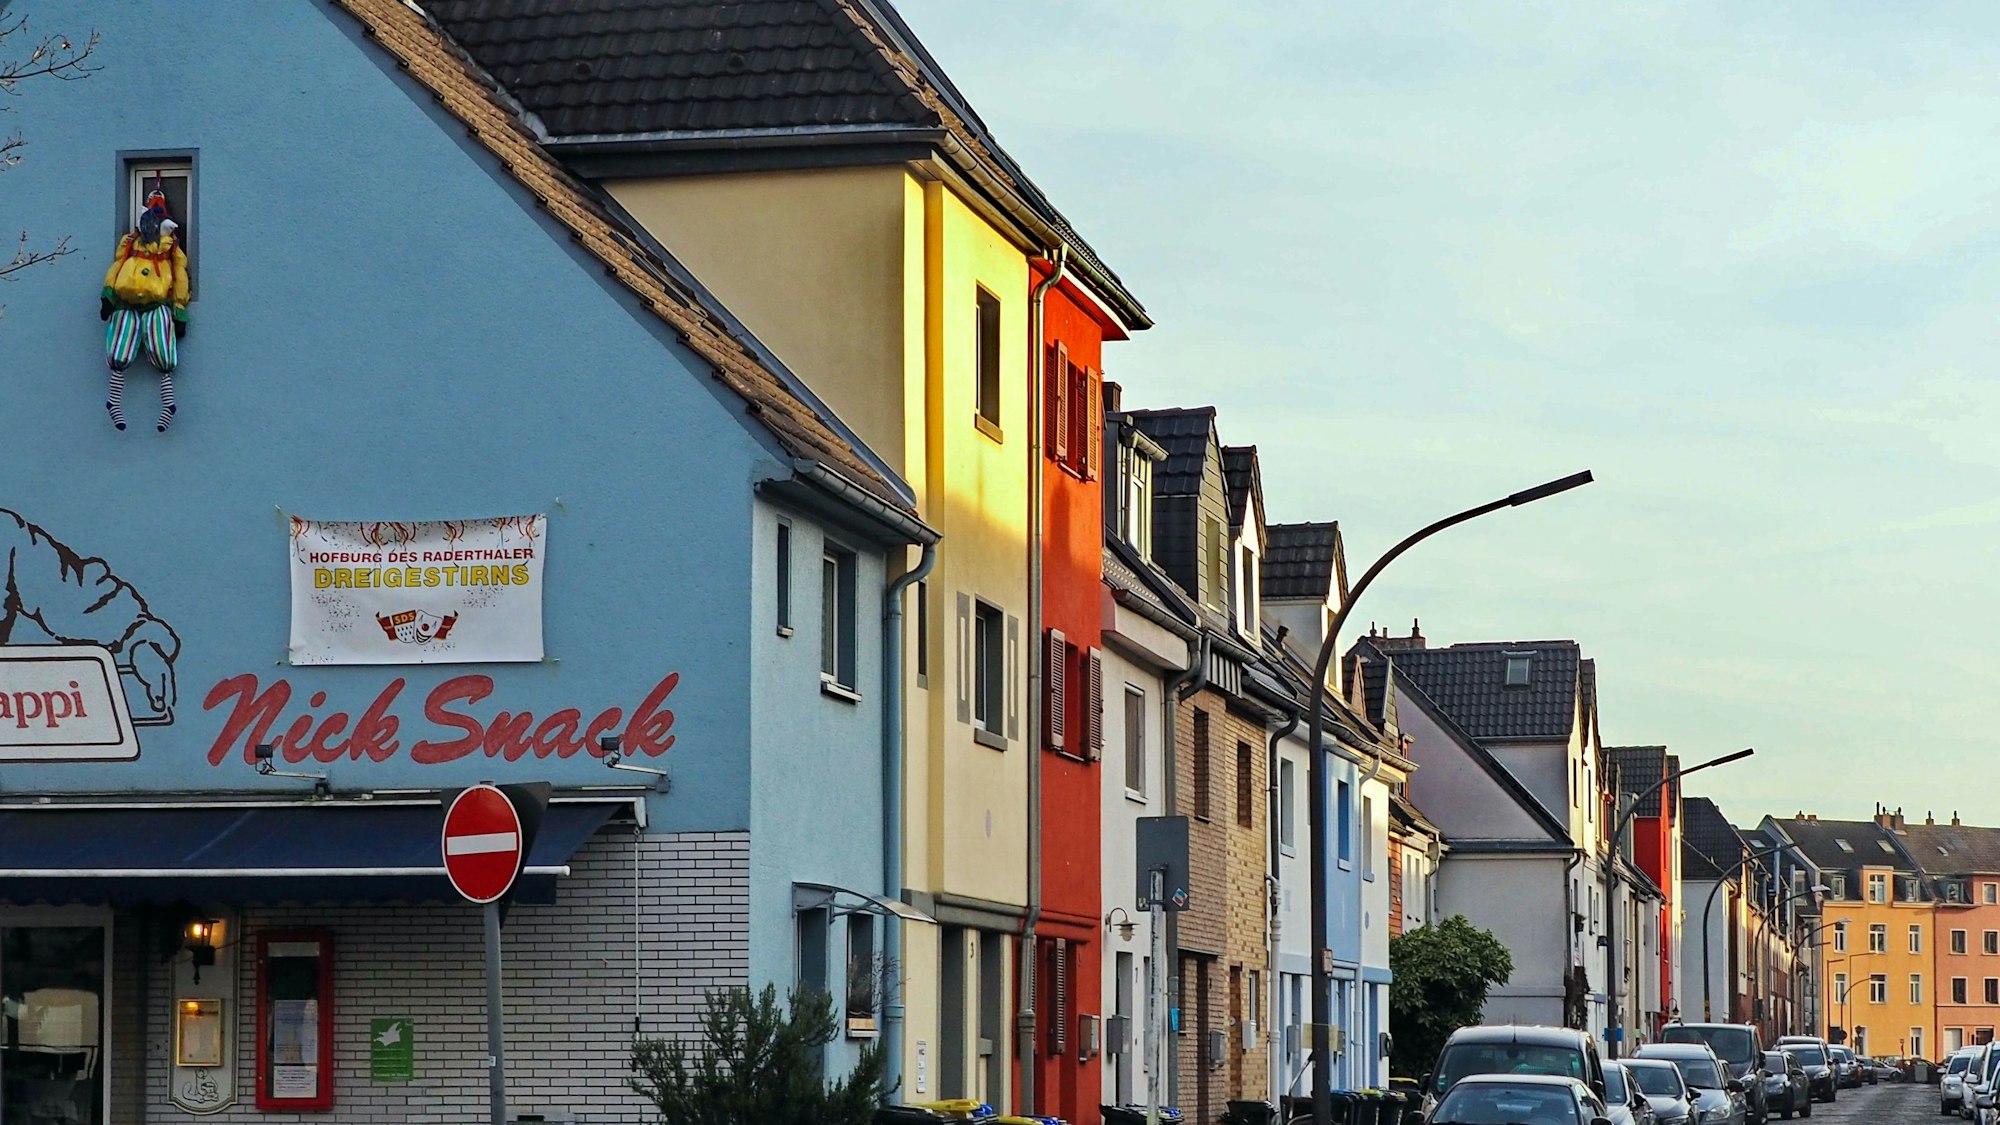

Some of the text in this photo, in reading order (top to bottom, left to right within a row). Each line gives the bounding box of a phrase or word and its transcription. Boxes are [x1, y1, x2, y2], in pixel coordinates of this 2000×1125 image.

[309, 548, 533, 563] HOFBURG DES RADERTHALER
[314, 564, 529, 589] DREIGESTIRNS
[394, 612, 416, 624] SDS
[203, 672, 680, 767] Nick Snack
